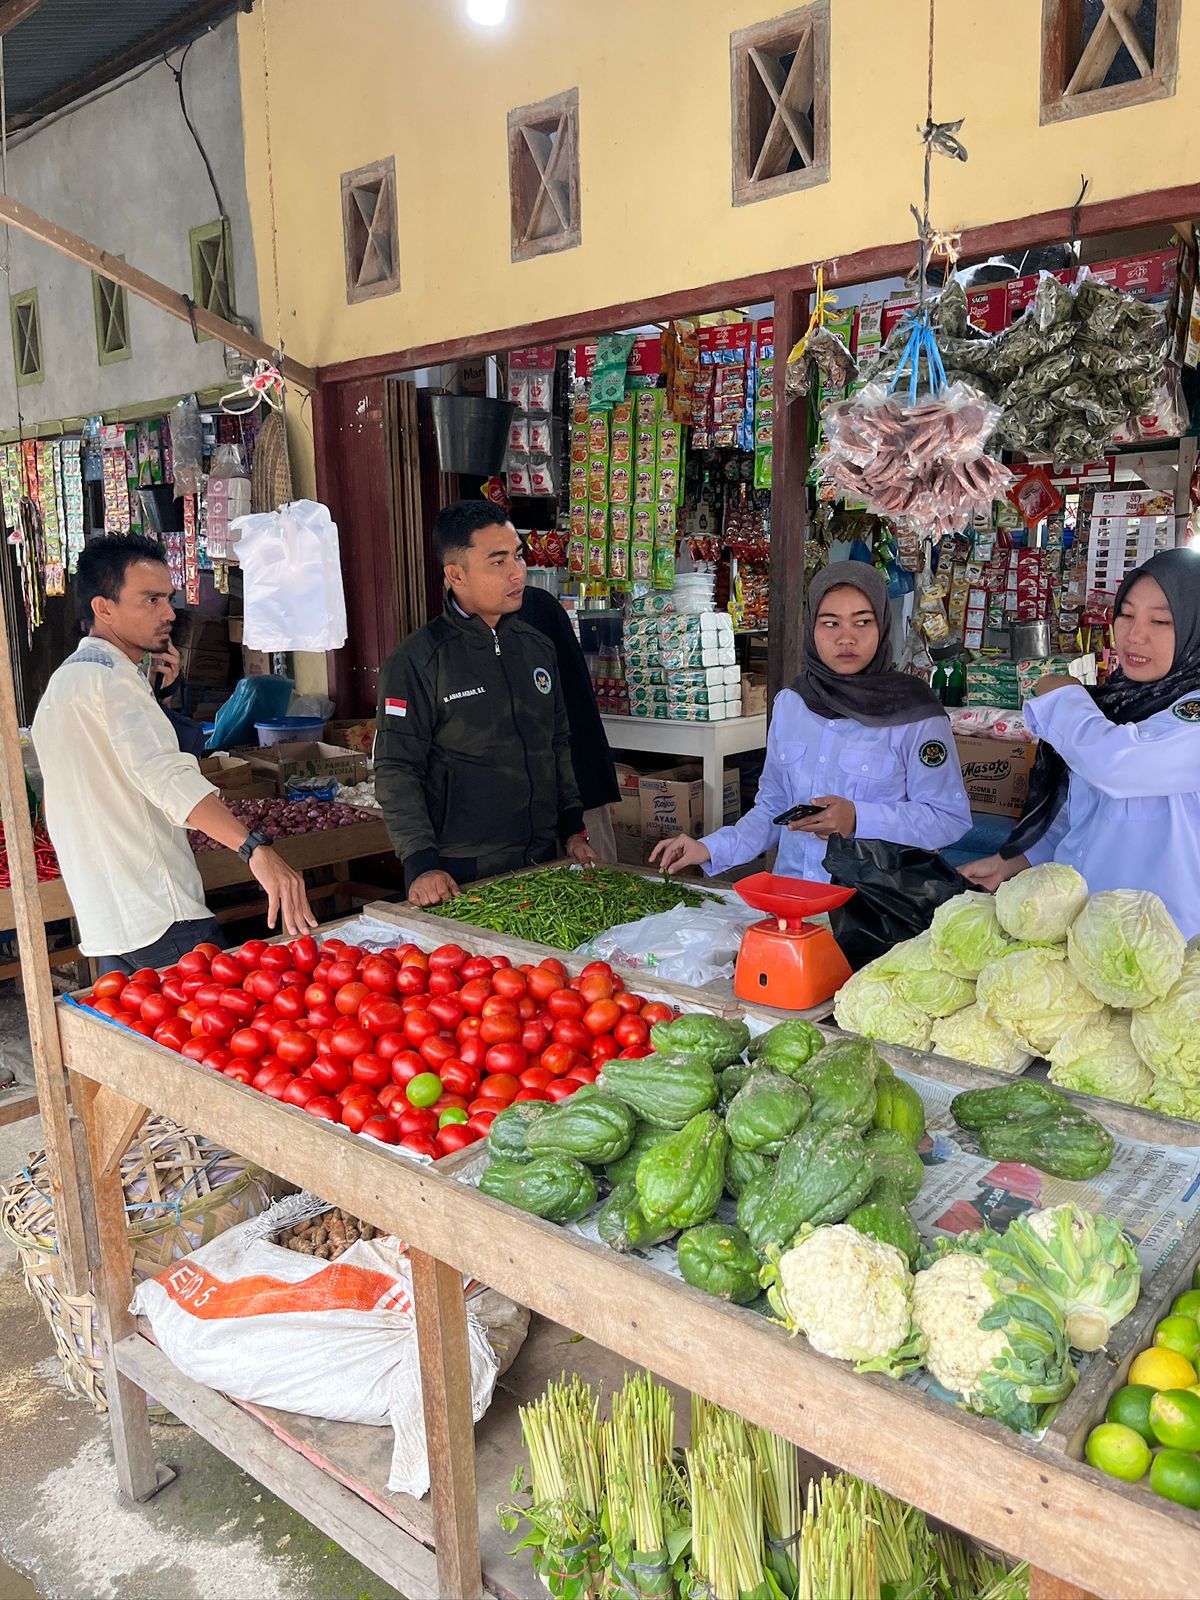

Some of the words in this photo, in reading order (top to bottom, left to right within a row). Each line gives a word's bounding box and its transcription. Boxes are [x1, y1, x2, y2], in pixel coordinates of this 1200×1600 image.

[961, 760, 1009, 777] Masako
[654, 815, 677, 823] AYAM
[1142, 1210, 1177, 1247] OLAHRAGA
[194, 1286, 218, 1307] 5
